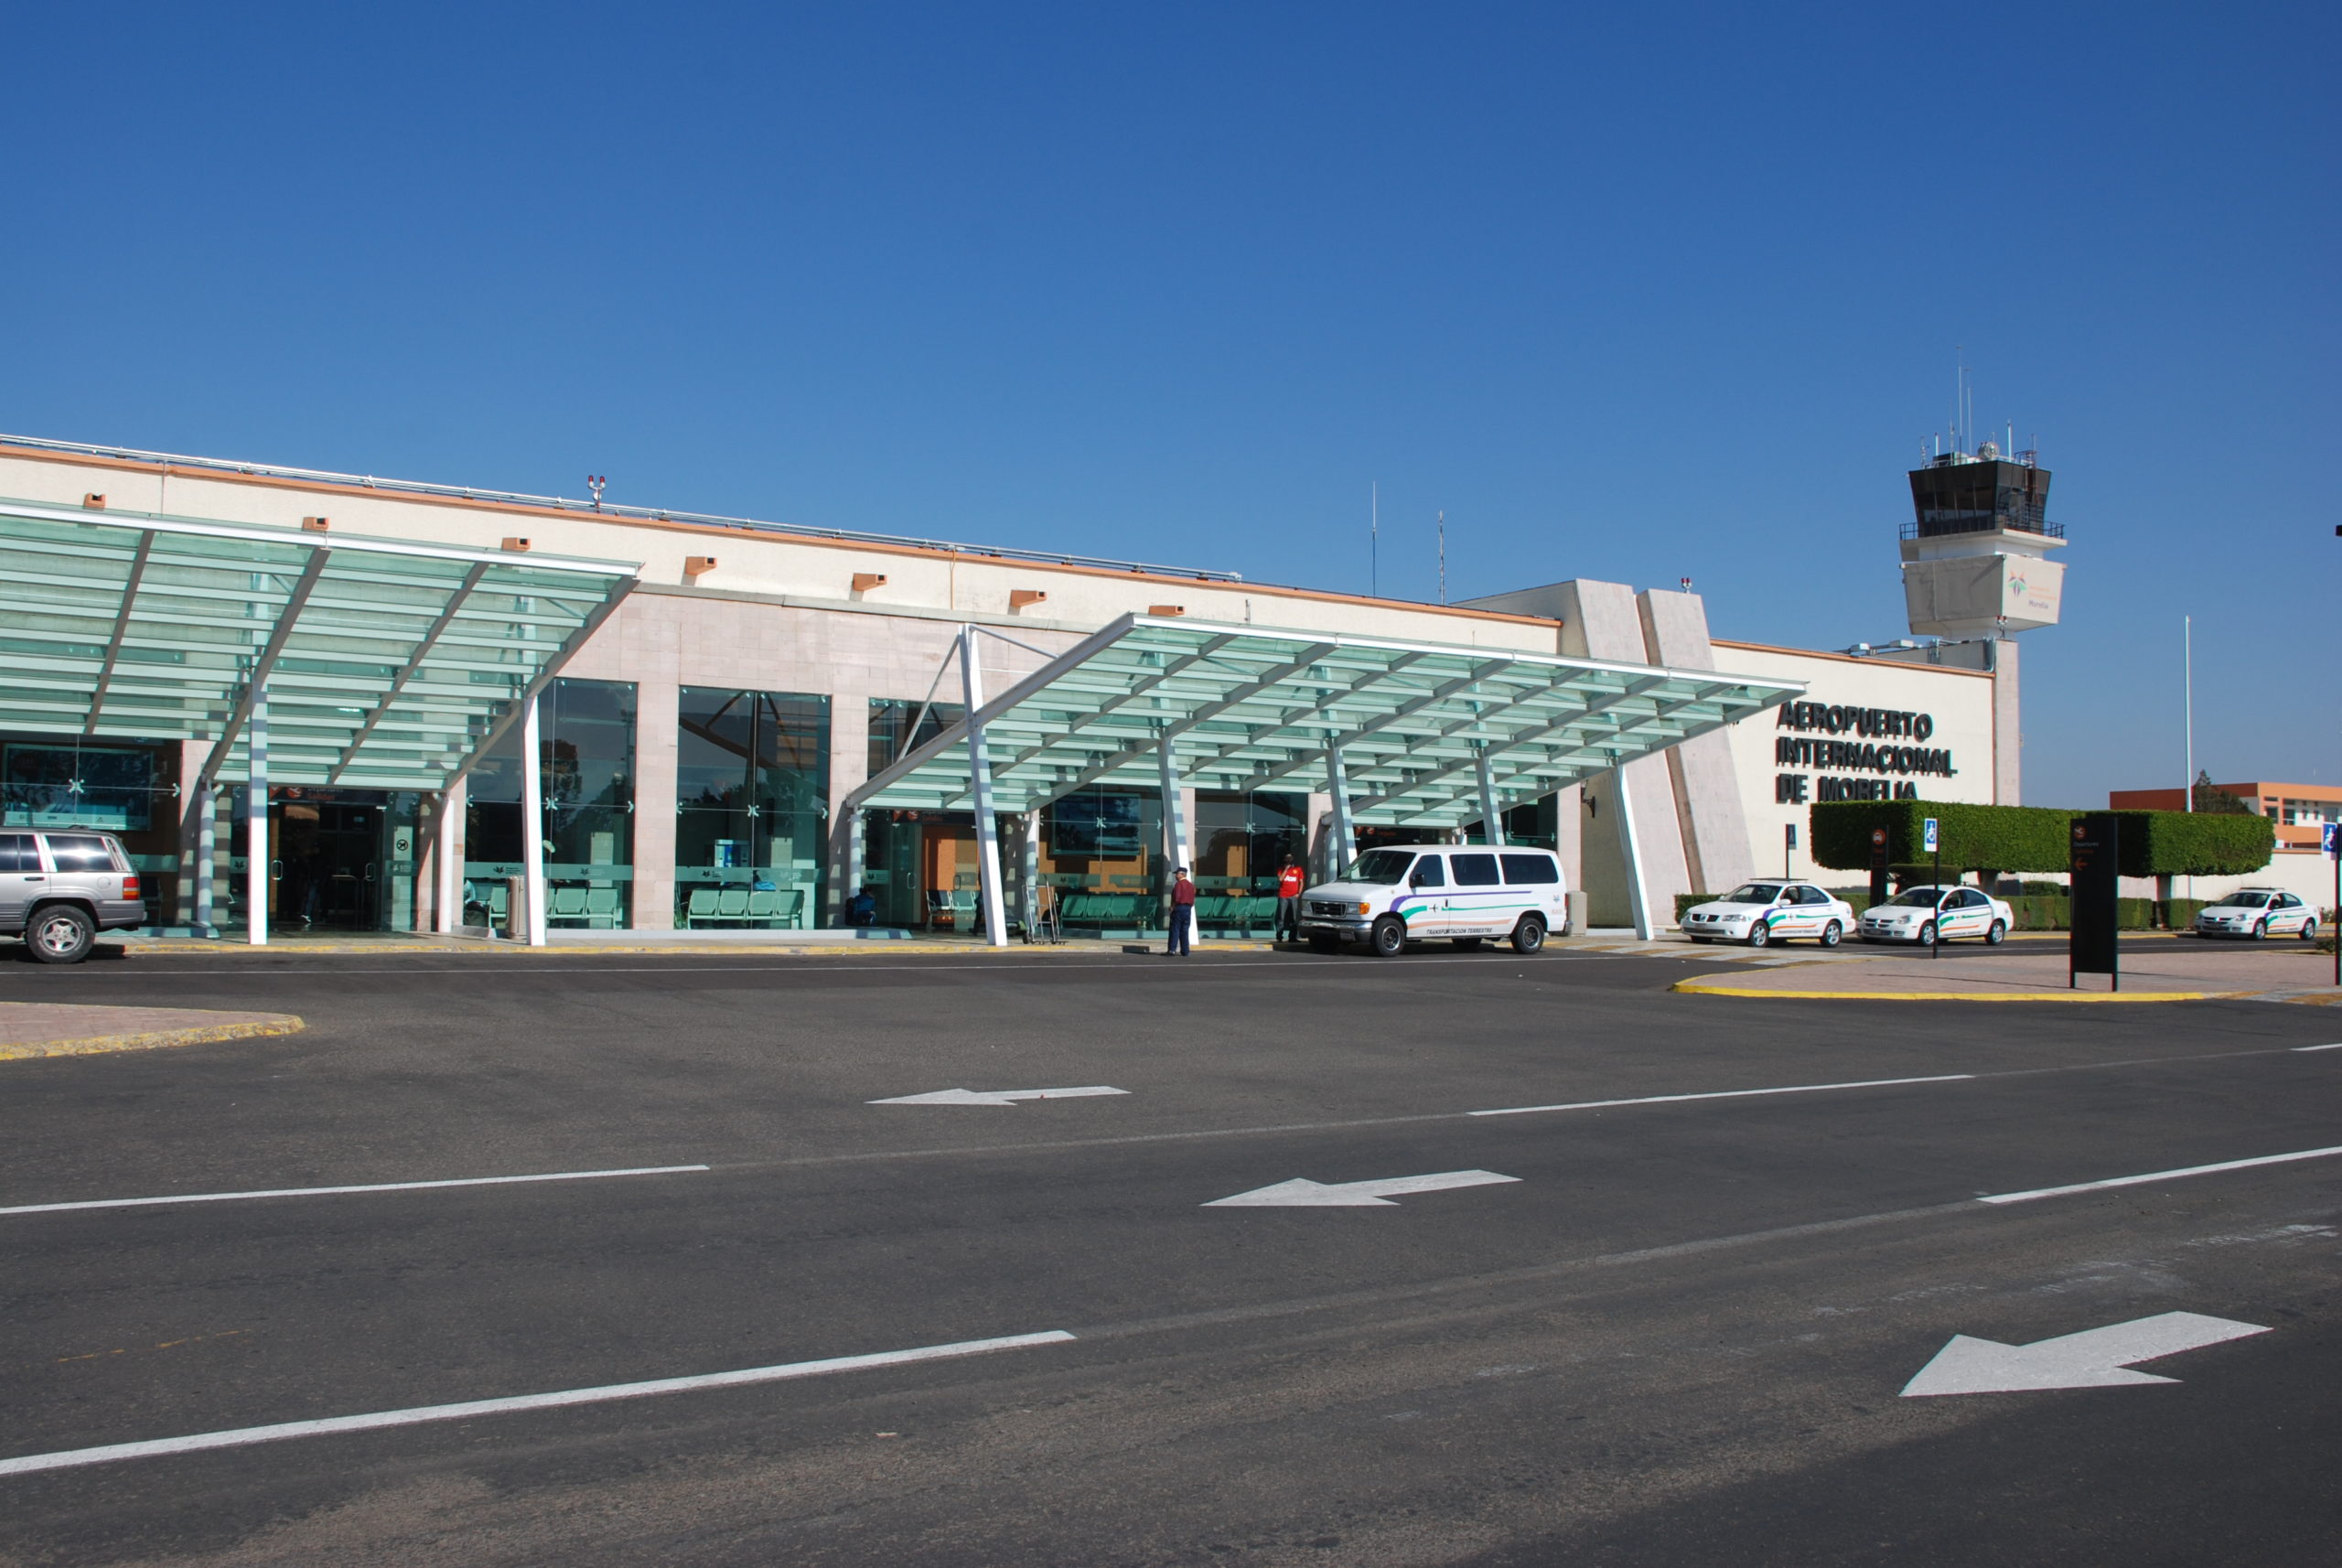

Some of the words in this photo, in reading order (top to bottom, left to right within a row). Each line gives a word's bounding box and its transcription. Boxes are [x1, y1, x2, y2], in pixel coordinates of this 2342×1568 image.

[1776, 701, 1933, 743] AEROPUERTO
[1776, 736, 1958, 778] INTERNACIONAL
[1776, 773, 1809, 804] DE
[1818, 776, 1918, 801] MORELIA
